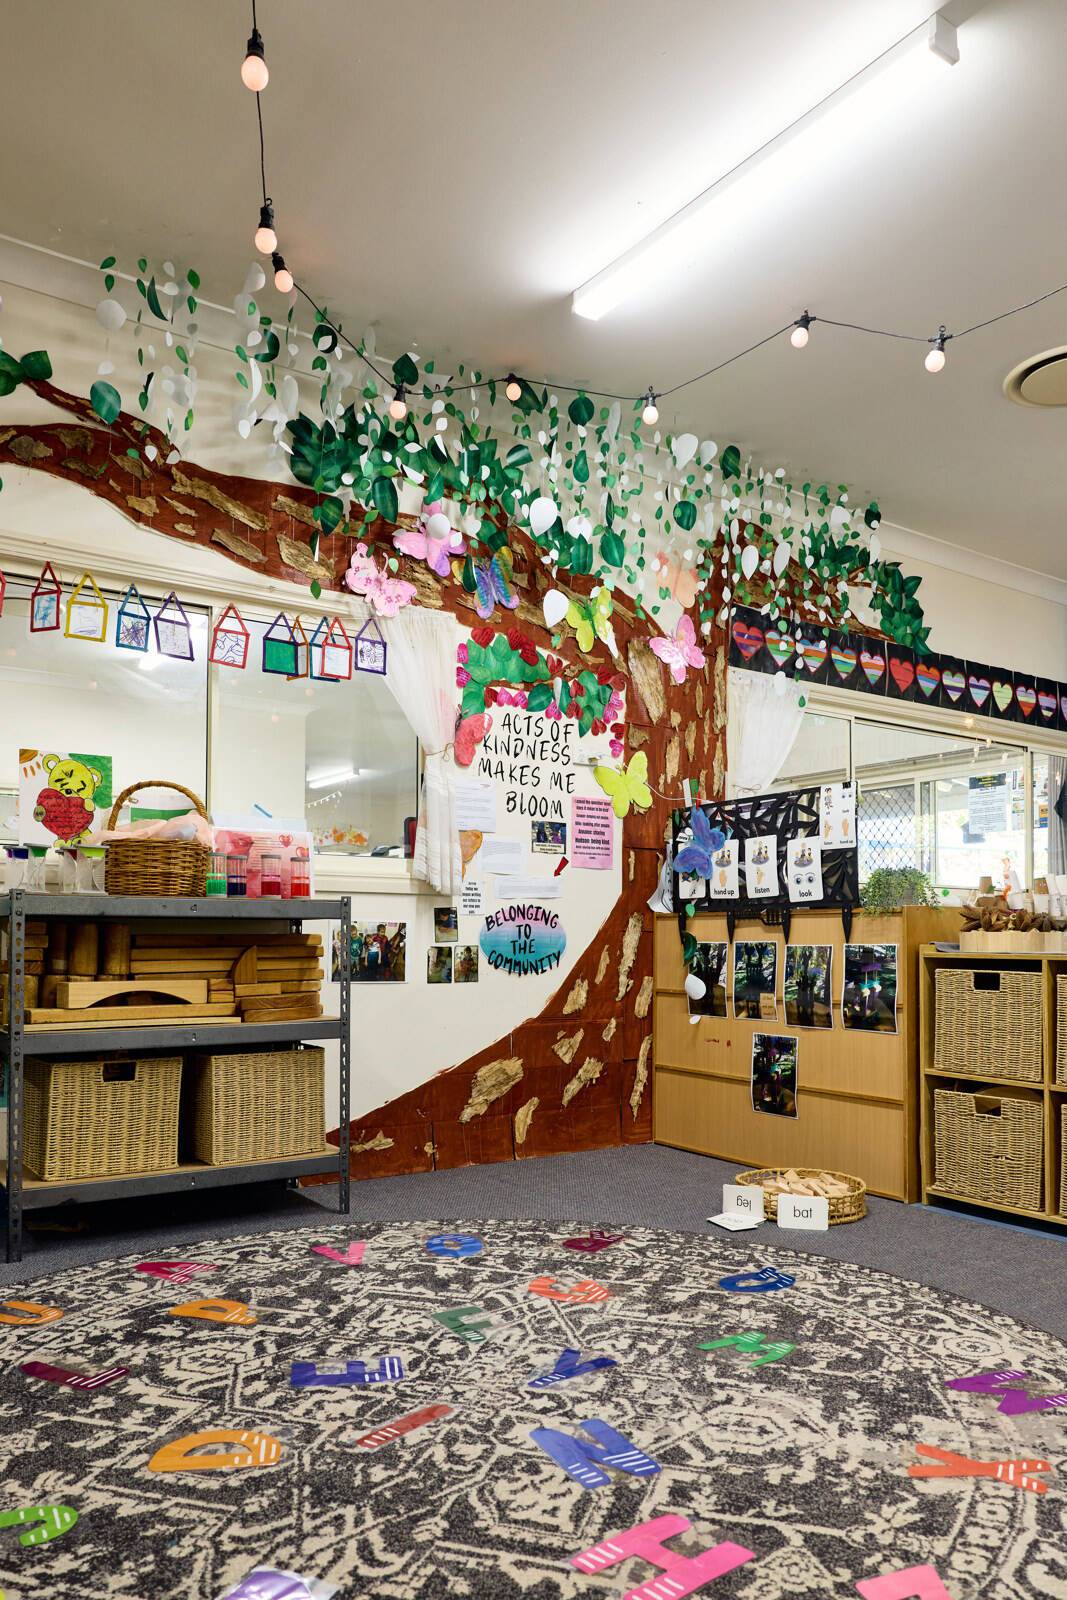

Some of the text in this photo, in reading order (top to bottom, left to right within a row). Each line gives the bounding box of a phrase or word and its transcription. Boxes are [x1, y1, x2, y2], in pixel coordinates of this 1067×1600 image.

[501, 713, 574, 743] ACTS OF
[483, 734, 571, 766] KINDNESS
[478, 758, 575, 794] MAKES ME
[506, 790, 564, 818] BLOOM
[754, 886, 770, 894] listen
[799, 890, 812, 898] look
[485, 904, 559, 931] BELONGING
[516, 924, 531, 940] TO
[510, 939, 535, 955] THE
[488, 950, 560, 977] COMMUNITY
[736, 1195, 752, 1211] leg
[793, 1206, 813, 1218] bat
[907, 1443, 1051, 1495] X
